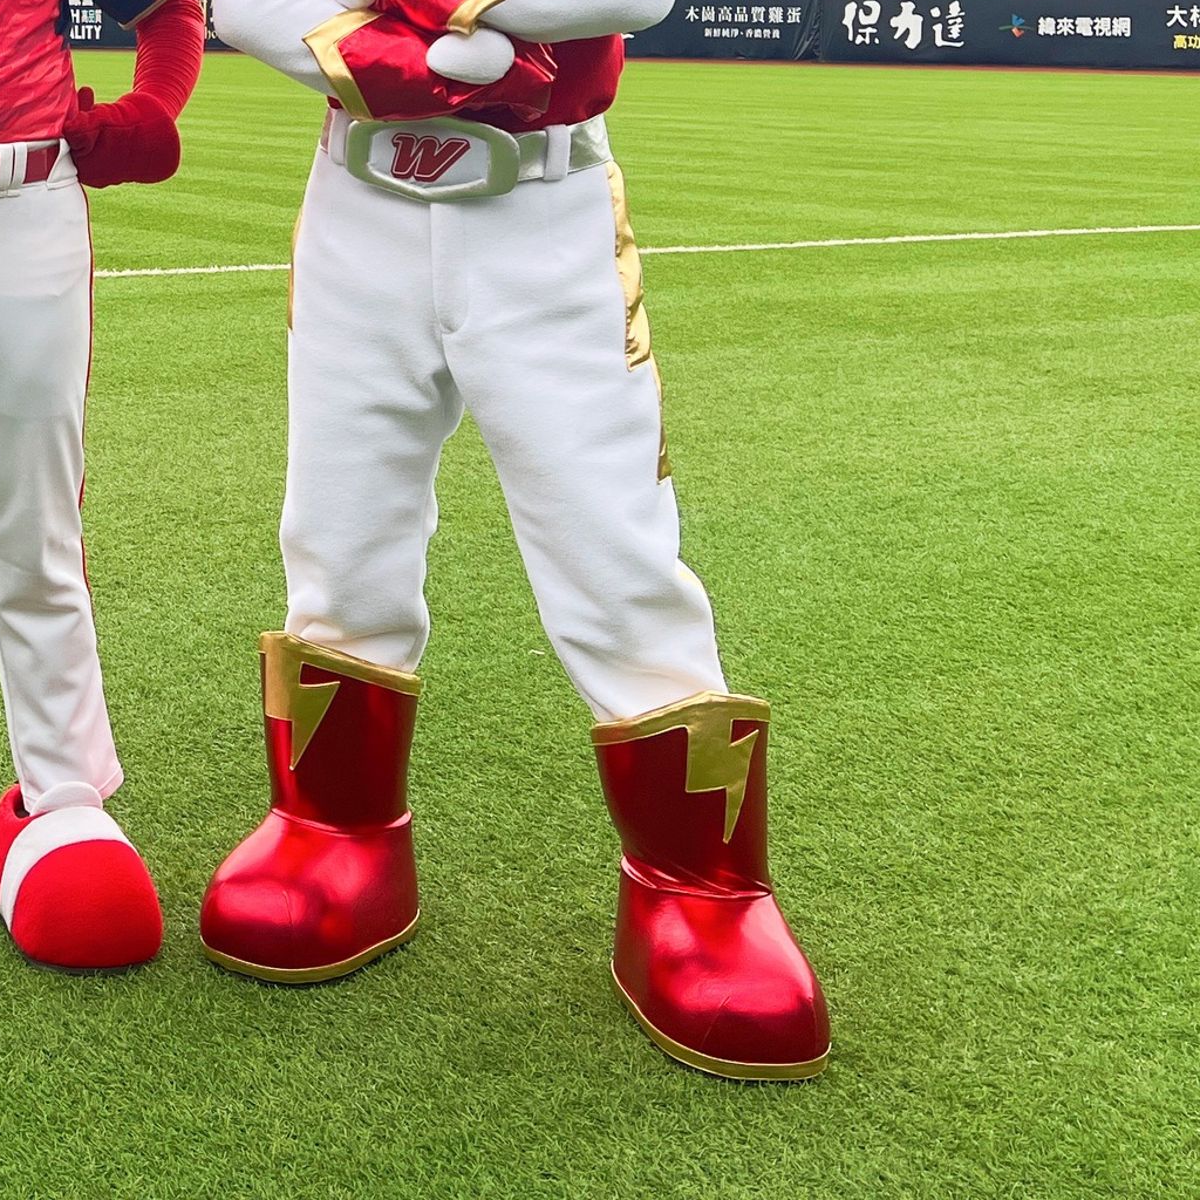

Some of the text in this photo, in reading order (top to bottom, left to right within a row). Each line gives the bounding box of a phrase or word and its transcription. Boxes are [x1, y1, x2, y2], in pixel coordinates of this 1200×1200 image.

[841, 0, 966, 50] 保力達
[1037, 16, 1132, 38] 緯來電視網
[391, 133, 471, 183] W
